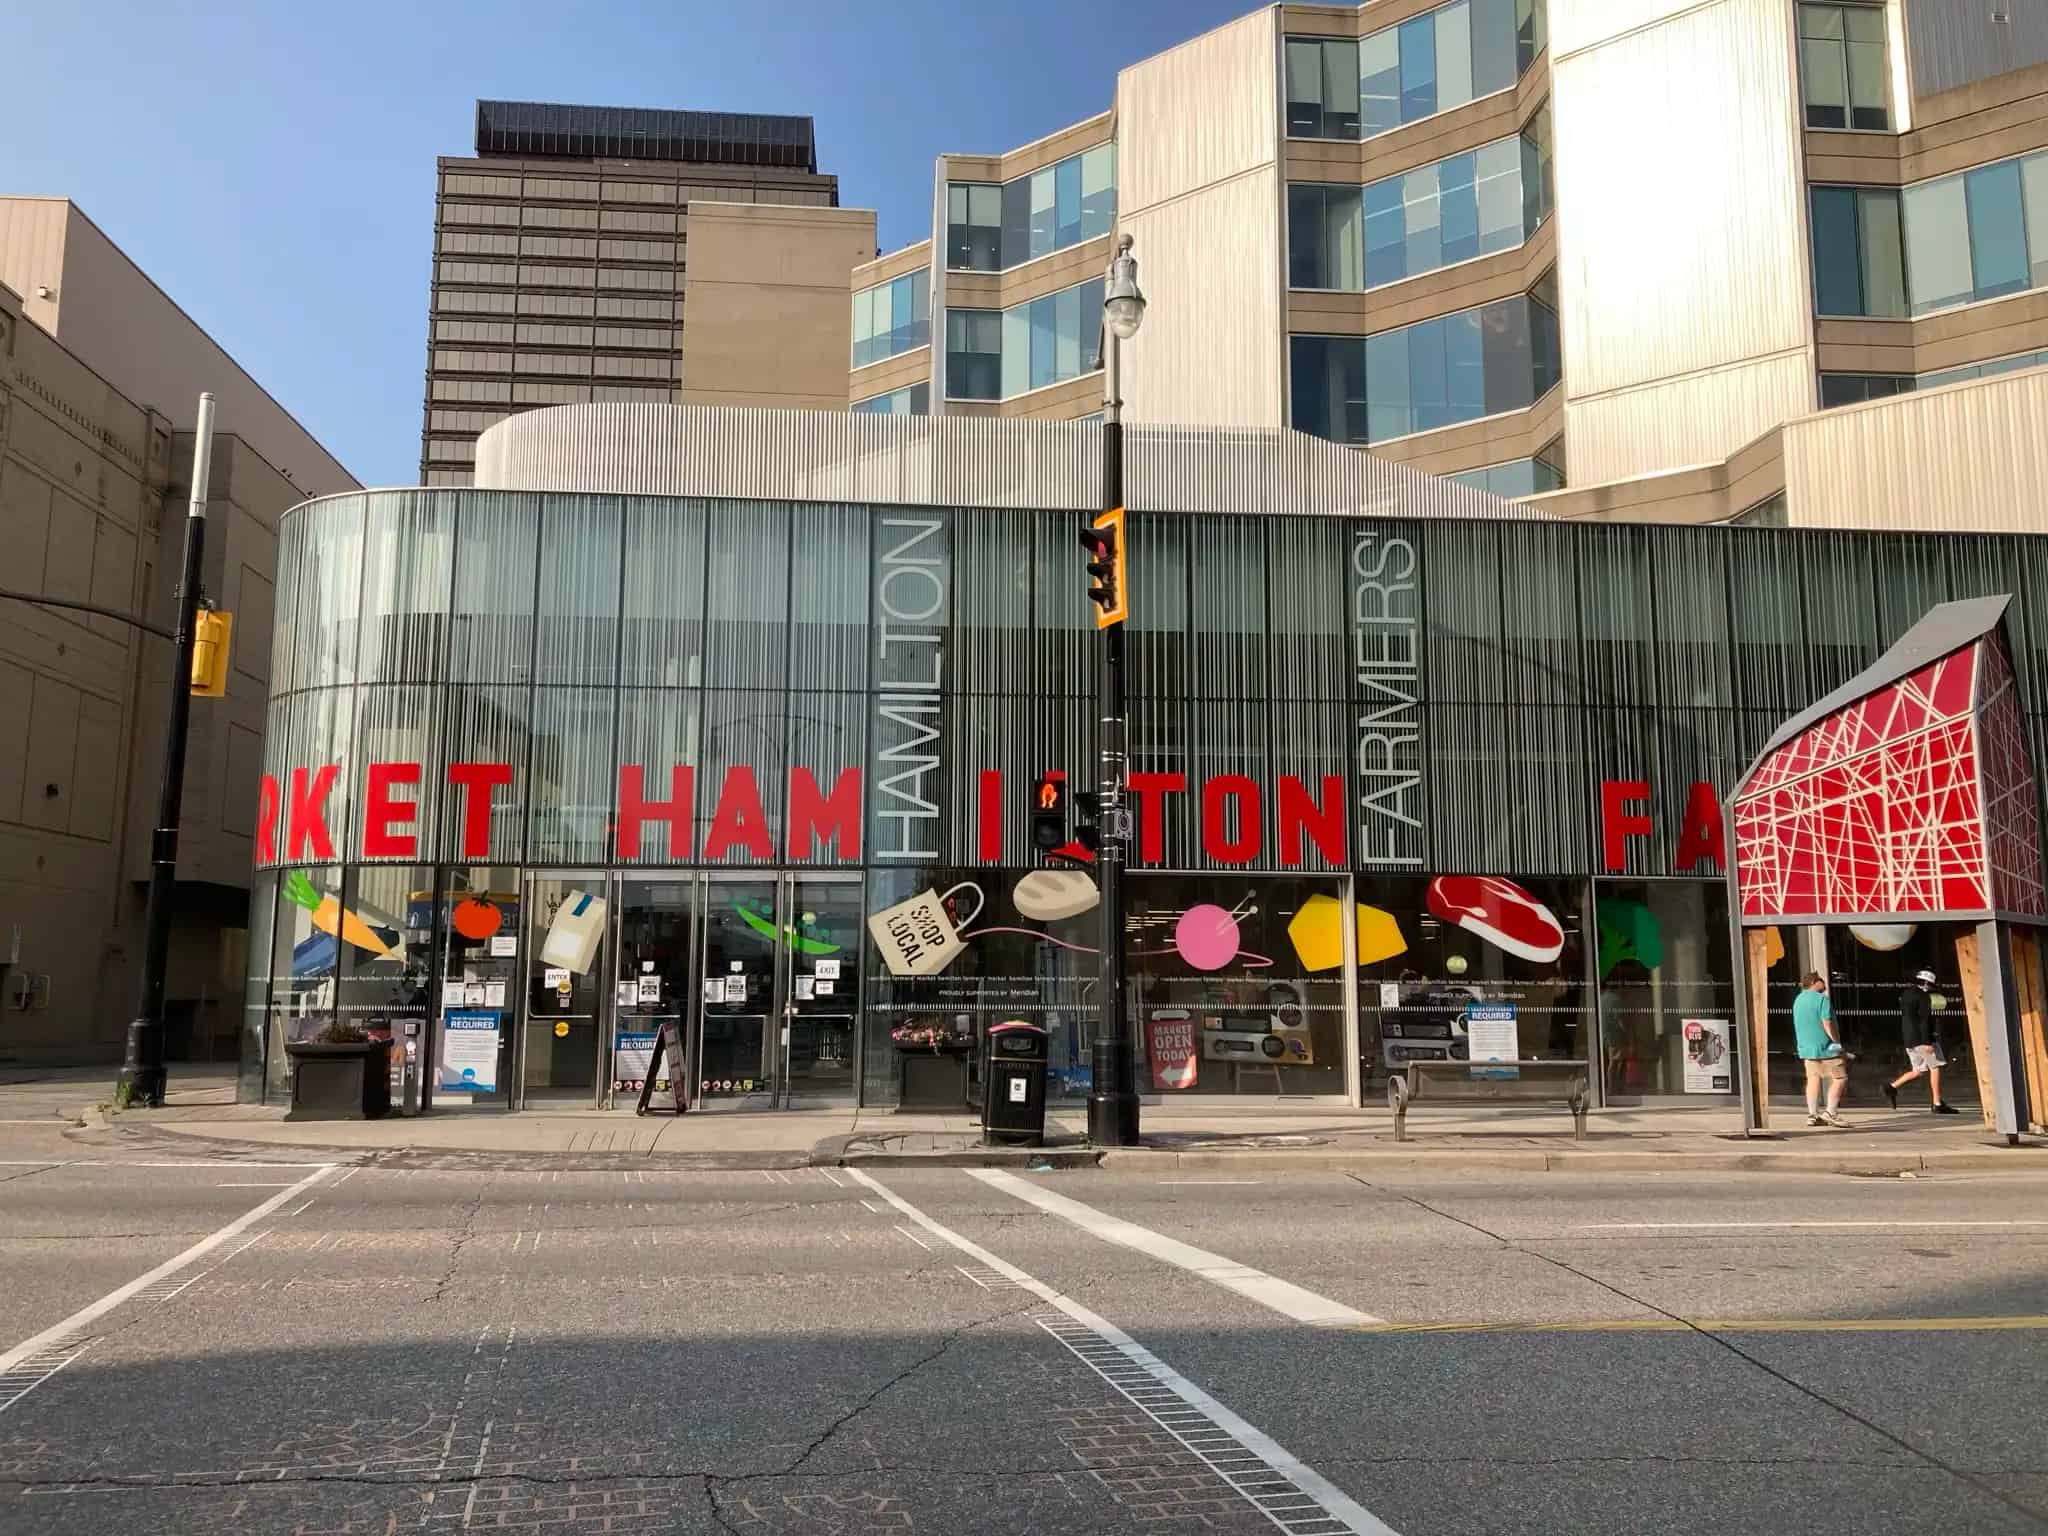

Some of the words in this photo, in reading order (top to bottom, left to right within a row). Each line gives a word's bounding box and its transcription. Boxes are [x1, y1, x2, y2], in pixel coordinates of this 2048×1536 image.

[877, 519, 943, 859] HAMILTON
[1353, 529, 1424, 865] FARMERS'
[911, 904, 946, 947] SHOP
[887, 913, 924, 967] LOCAL
[1471, 1012, 1512, 1020] REQUIRED
[450, 1020, 495, 1029] REQUIRED
[1154, 1024, 1193, 1035] MARKET
[1154, 1035, 1193, 1049] OPEN
[1155, 1049, 1192, 1062] TODAY
